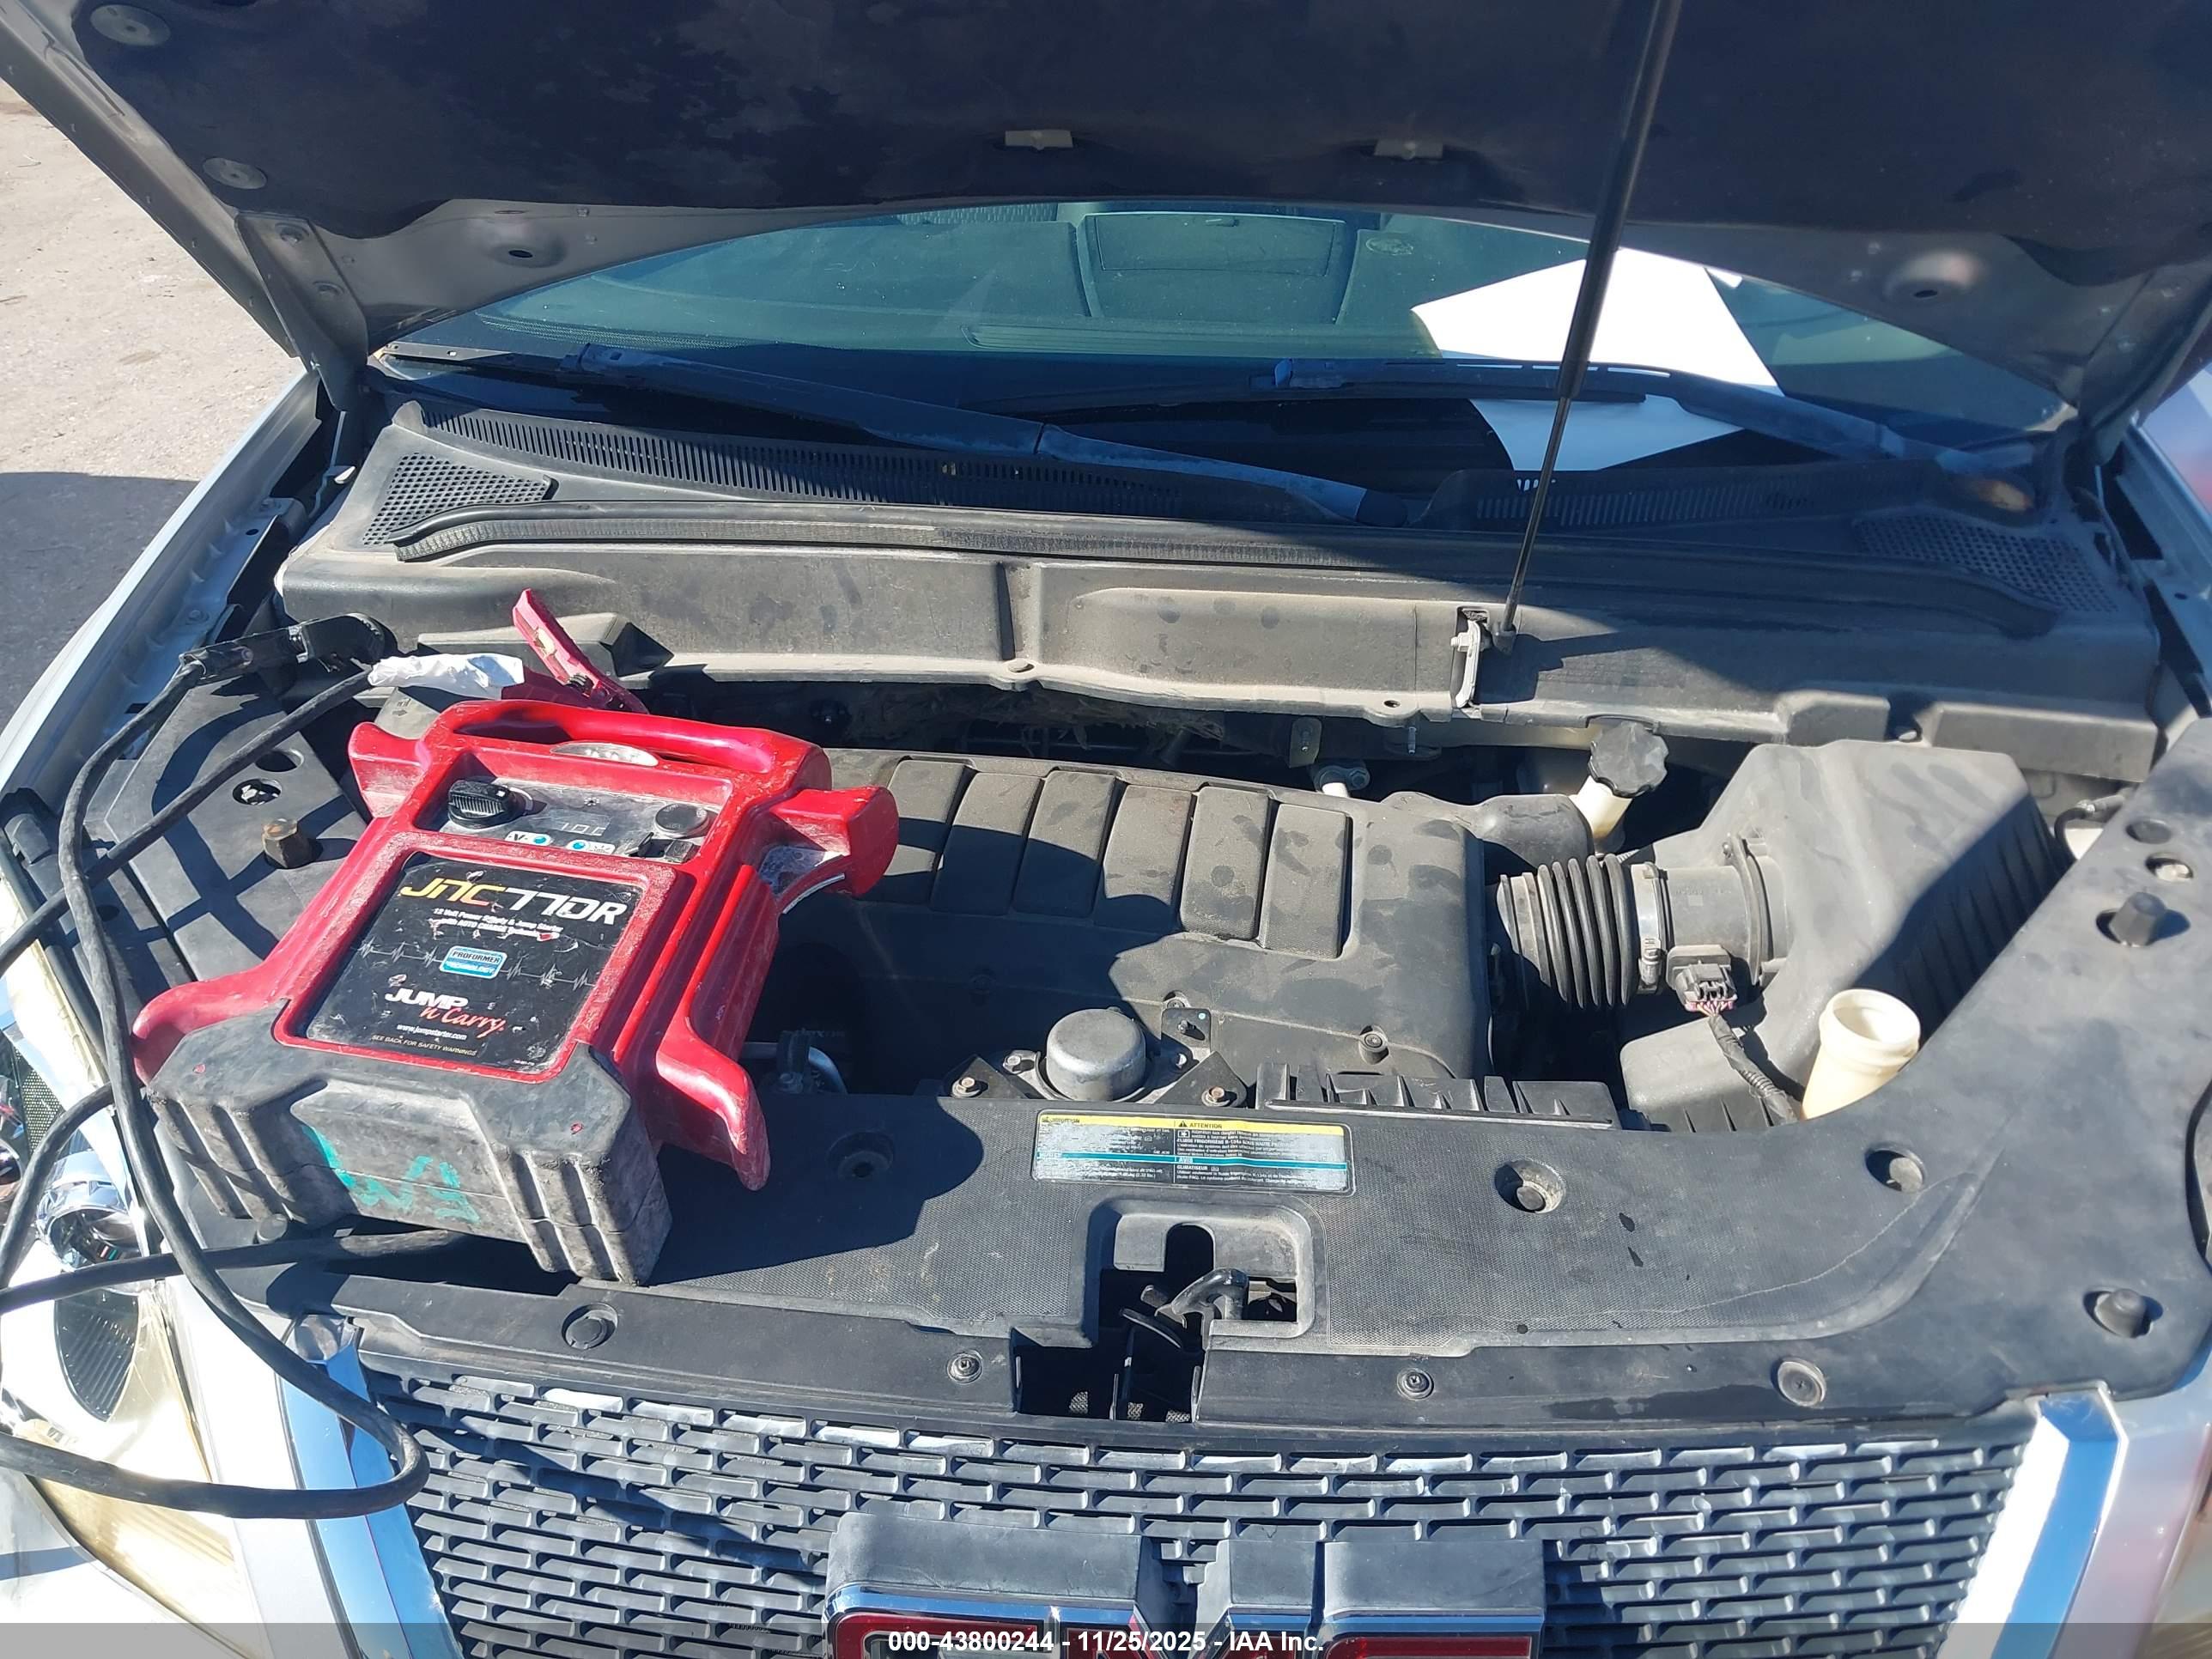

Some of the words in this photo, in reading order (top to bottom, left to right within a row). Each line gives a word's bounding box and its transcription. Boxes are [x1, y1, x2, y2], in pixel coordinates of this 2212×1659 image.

[400, 878, 628, 925] JNC770R
[444, 908, 459, 917] Volt
[459, 911, 483, 921] Power
[515, 921, 538, 930] Jump
[537, 922, 564, 933] Starter
[457, 920, 478, 928] AUTO
[453, 951, 501, 963] PROFORMER
[385, 988, 468, 1010] JUMP
[441, 1007, 507, 1038] Carry
[403, 1038, 418, 1047] FOR
[417, 1042, 443, 1050] SAFETY
[442, 1045, 477, 1057] WARNINGS
